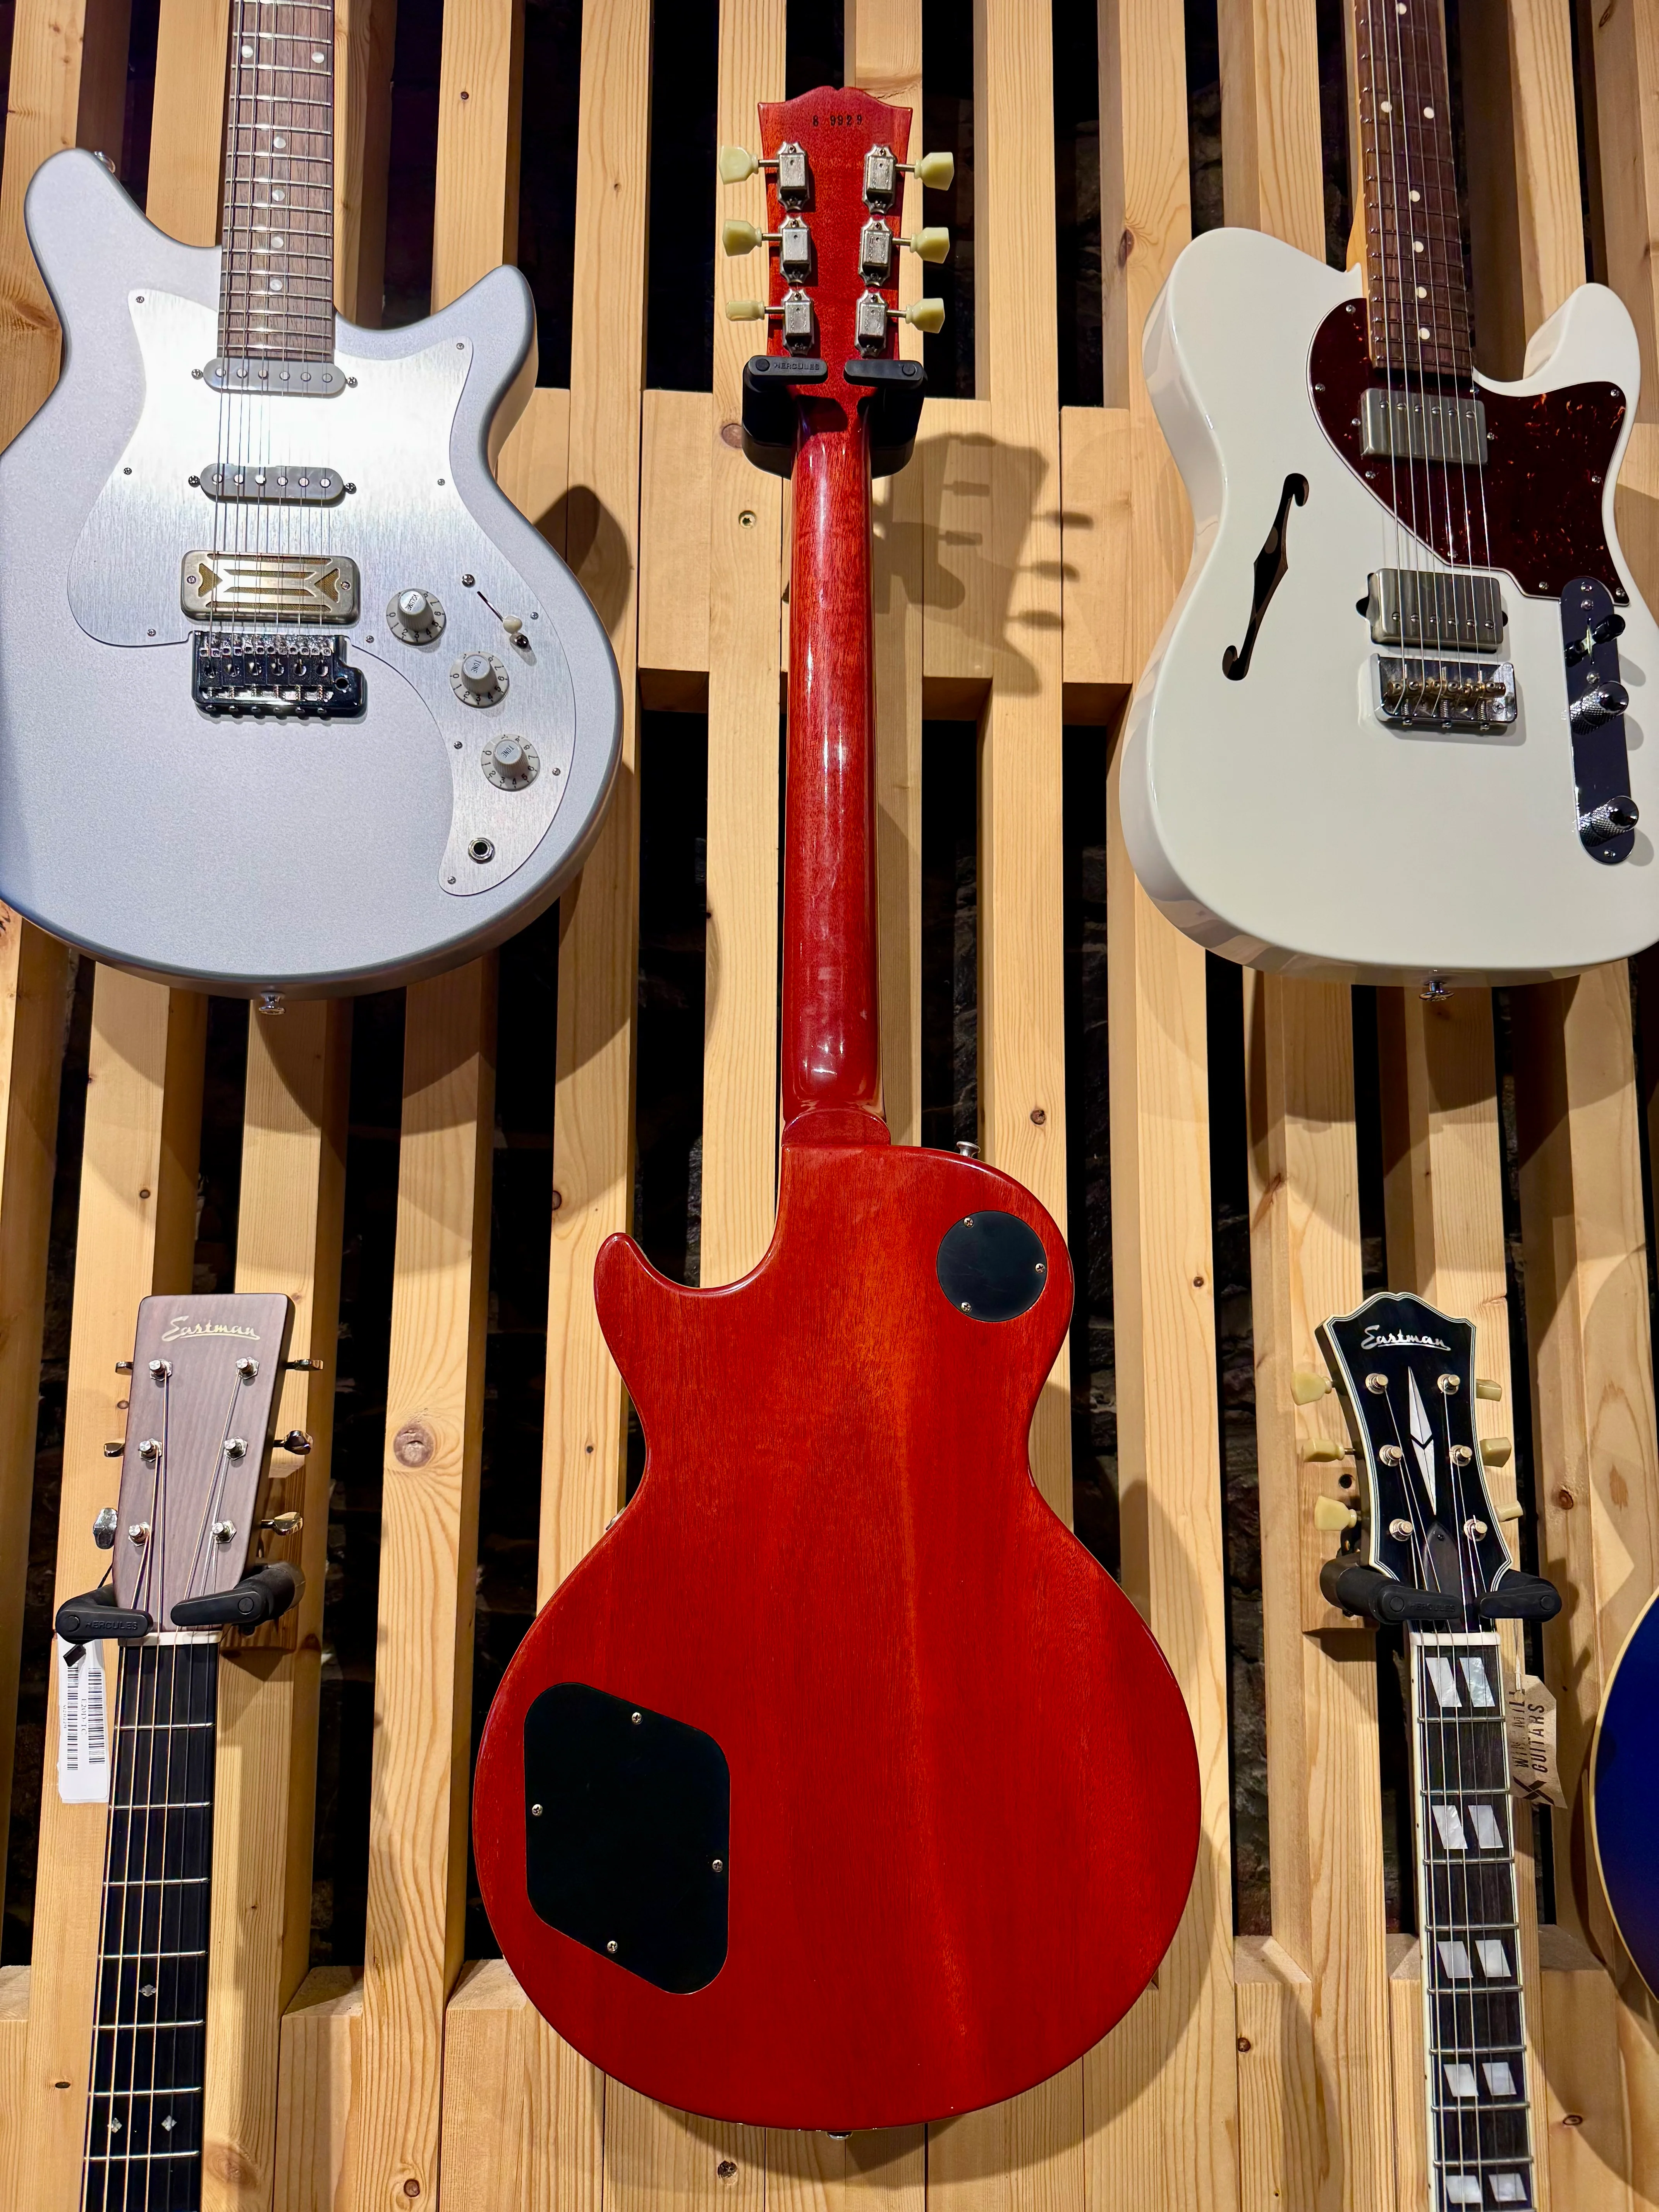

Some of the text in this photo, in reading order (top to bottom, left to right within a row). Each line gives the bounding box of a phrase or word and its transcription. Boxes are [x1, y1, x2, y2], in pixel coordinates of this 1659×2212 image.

[812, 114, 862, 127] 8 9929
[405, 594, 418, 611] VOLUME
[471, 660, 481, 673] TONE
[501, 745, 514, 758] TONE
[161, 1316, 260, 1341] Eastman
[1360, 1325, 1451, 1351] Eastman
[85, 1621, 138, 1630] HERCULES
[1509, 1688, 1529, 1768] WINMILL
[1527, 1704, 1548, 1773] GUITARS
